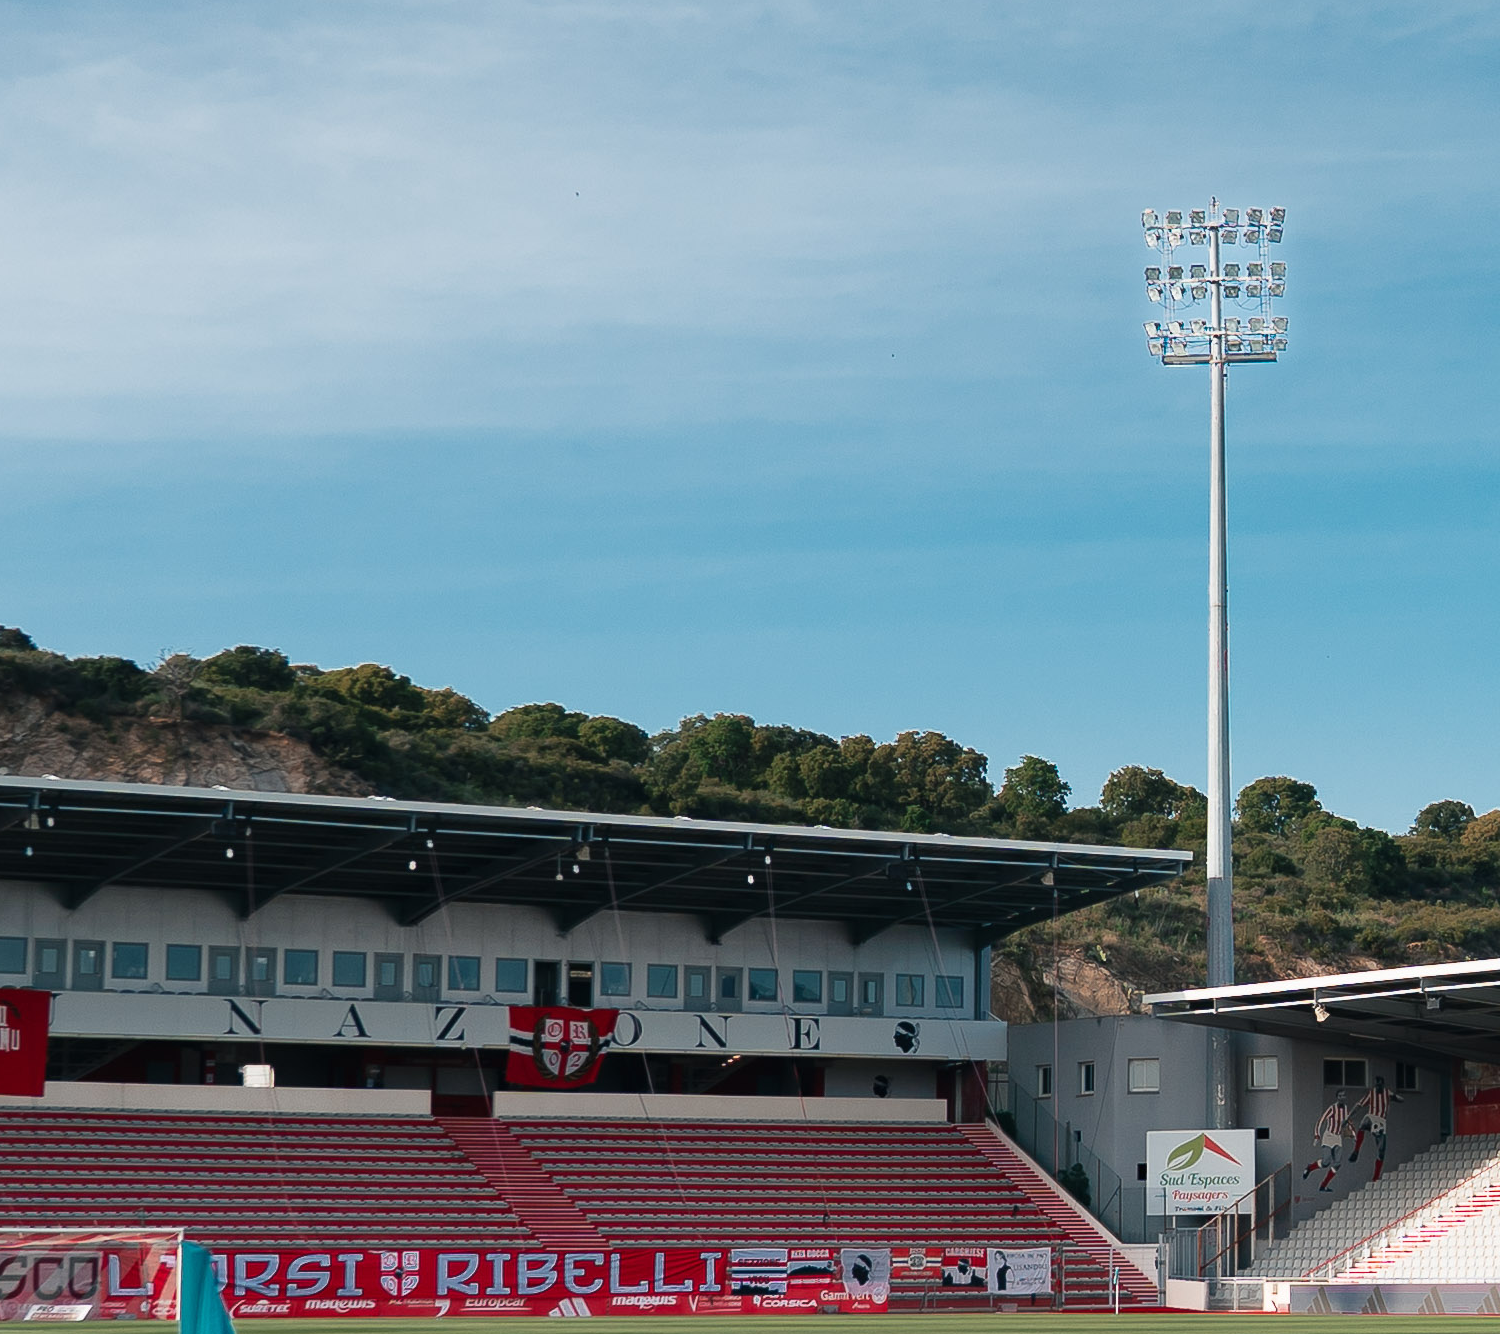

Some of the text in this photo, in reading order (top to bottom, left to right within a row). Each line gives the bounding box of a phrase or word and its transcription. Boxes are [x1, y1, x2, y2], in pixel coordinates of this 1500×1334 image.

[1160, 1172, 1240, 1189] Sud Espaces
[1171, 1189, 1229, 1203] Paysagers
[436, 1251, 722, 1295] RIBELLI
[762, 1299, 818, 1308] CORSICA
